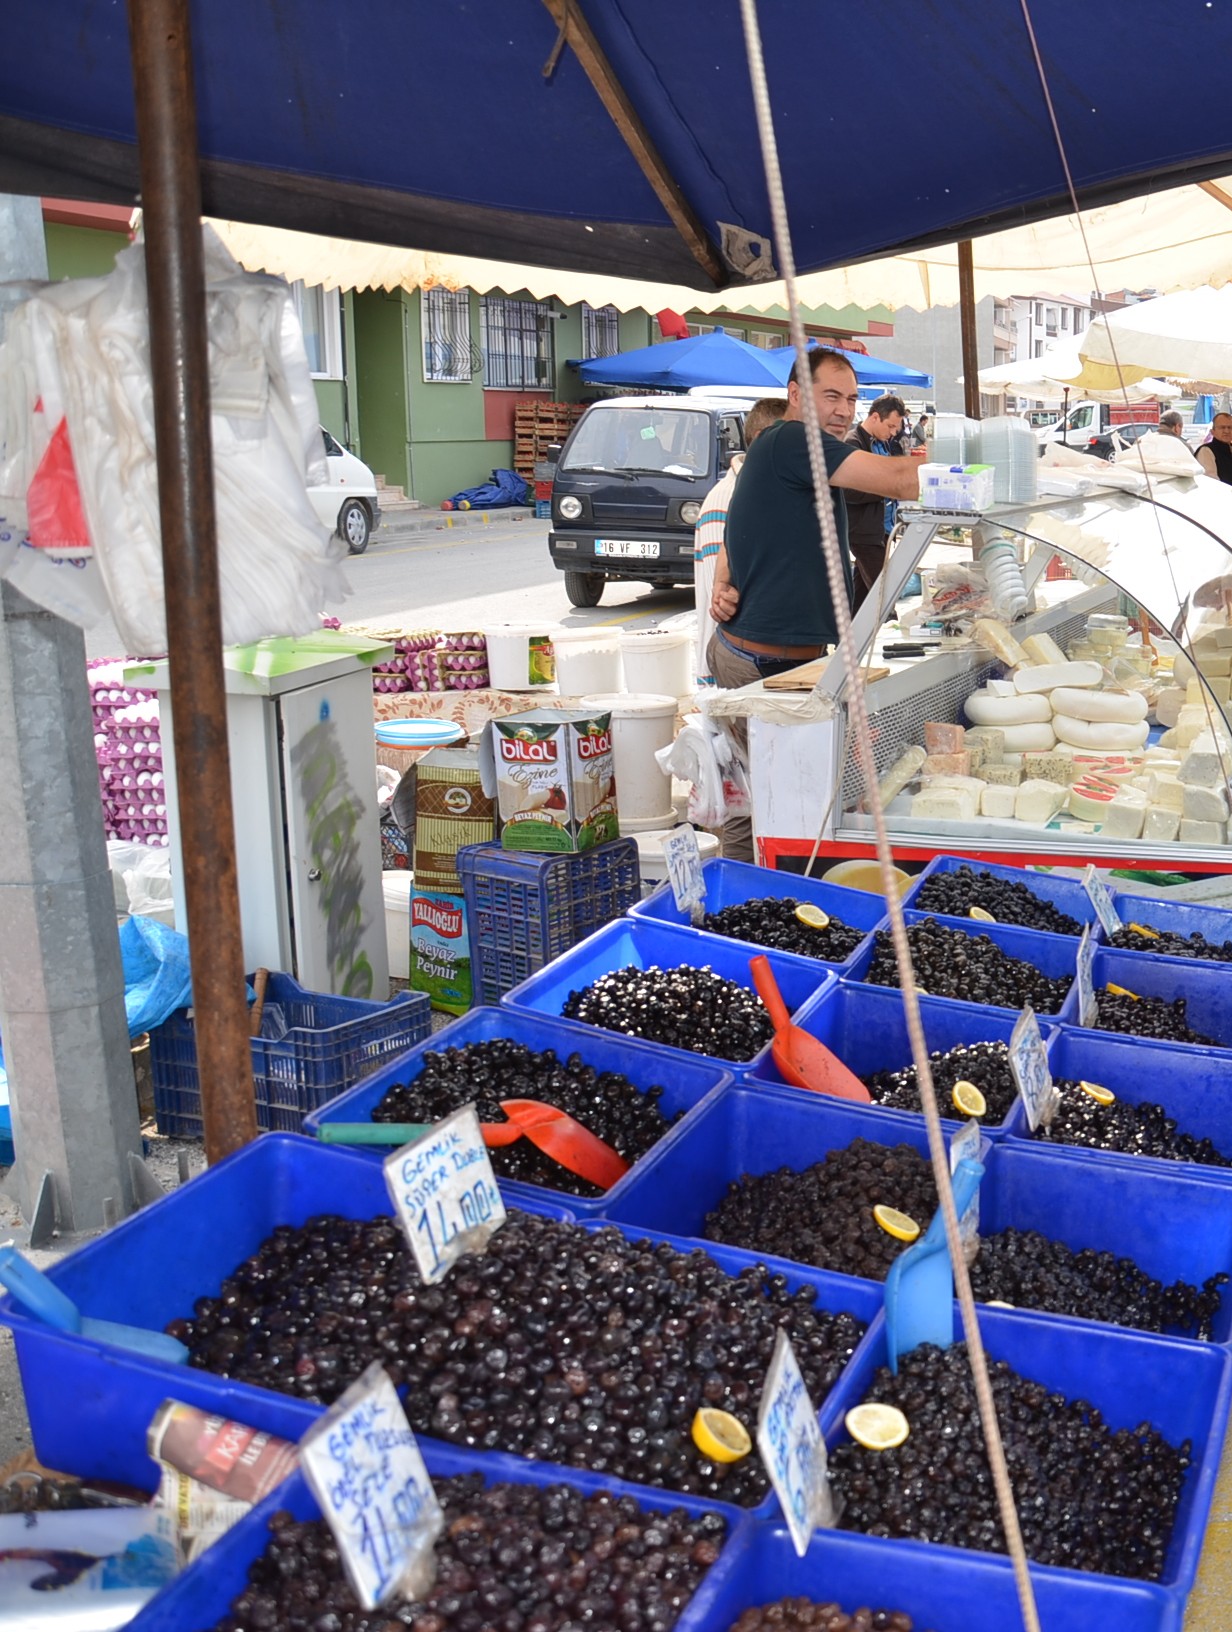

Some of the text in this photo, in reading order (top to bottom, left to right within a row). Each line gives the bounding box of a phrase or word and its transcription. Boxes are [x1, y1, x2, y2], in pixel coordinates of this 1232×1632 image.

[604, 542, 658, 555] 16 VF 312
[508, 763, 559, 790] Ezine
[417, 937, 457, 963] Beyaz
[416, 955, 458, 981] Peynir
